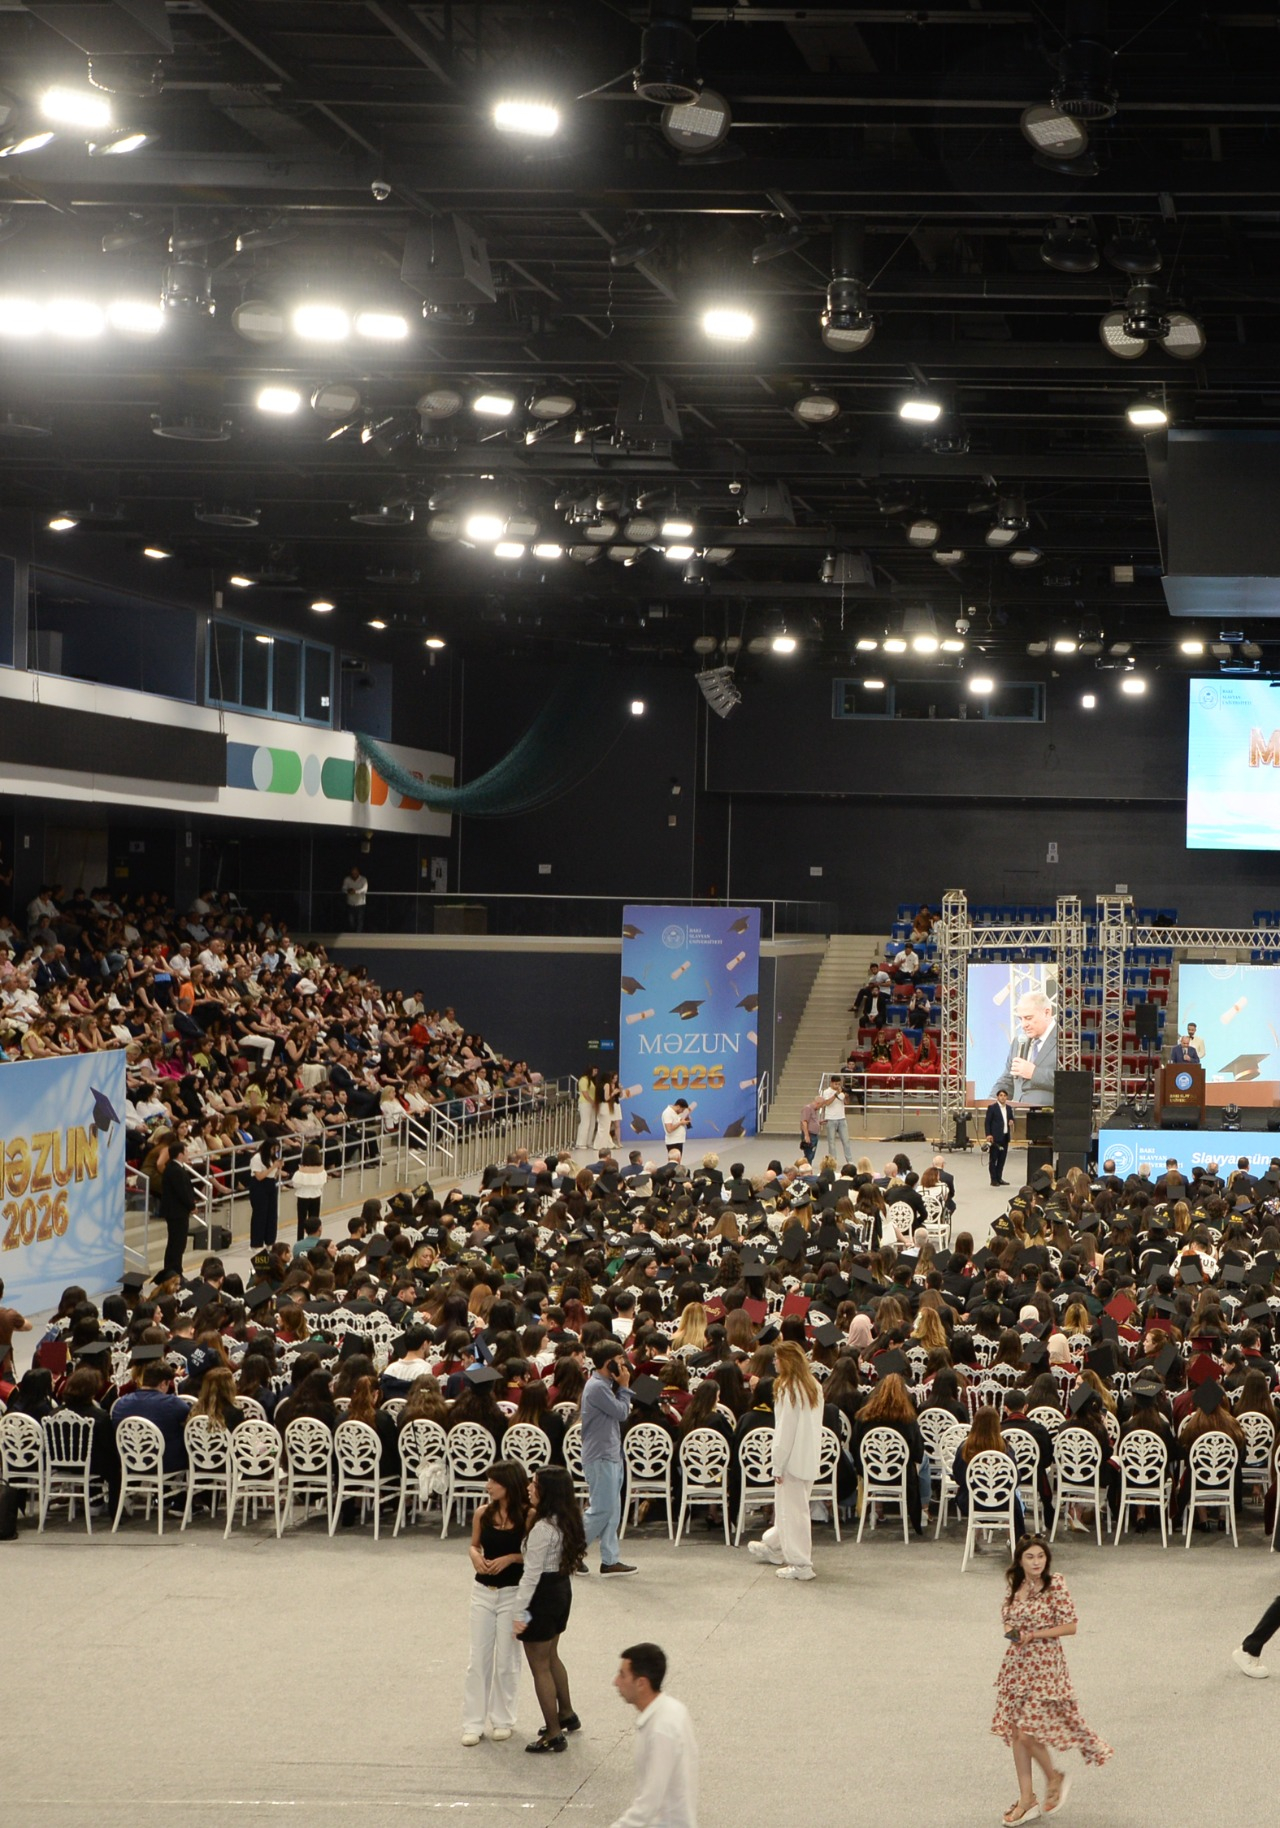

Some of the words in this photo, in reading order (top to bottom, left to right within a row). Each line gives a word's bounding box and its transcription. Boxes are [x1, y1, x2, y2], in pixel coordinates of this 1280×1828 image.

[638, 1033, 741, 1054] MƏZUN
[652, 1064, 725, 1091] 2026
[0, 1123, 98, 1200] ƏZUN
[2, 1190, 69, 1250] 2026
[254, 1256, 269, 1264] BSU
